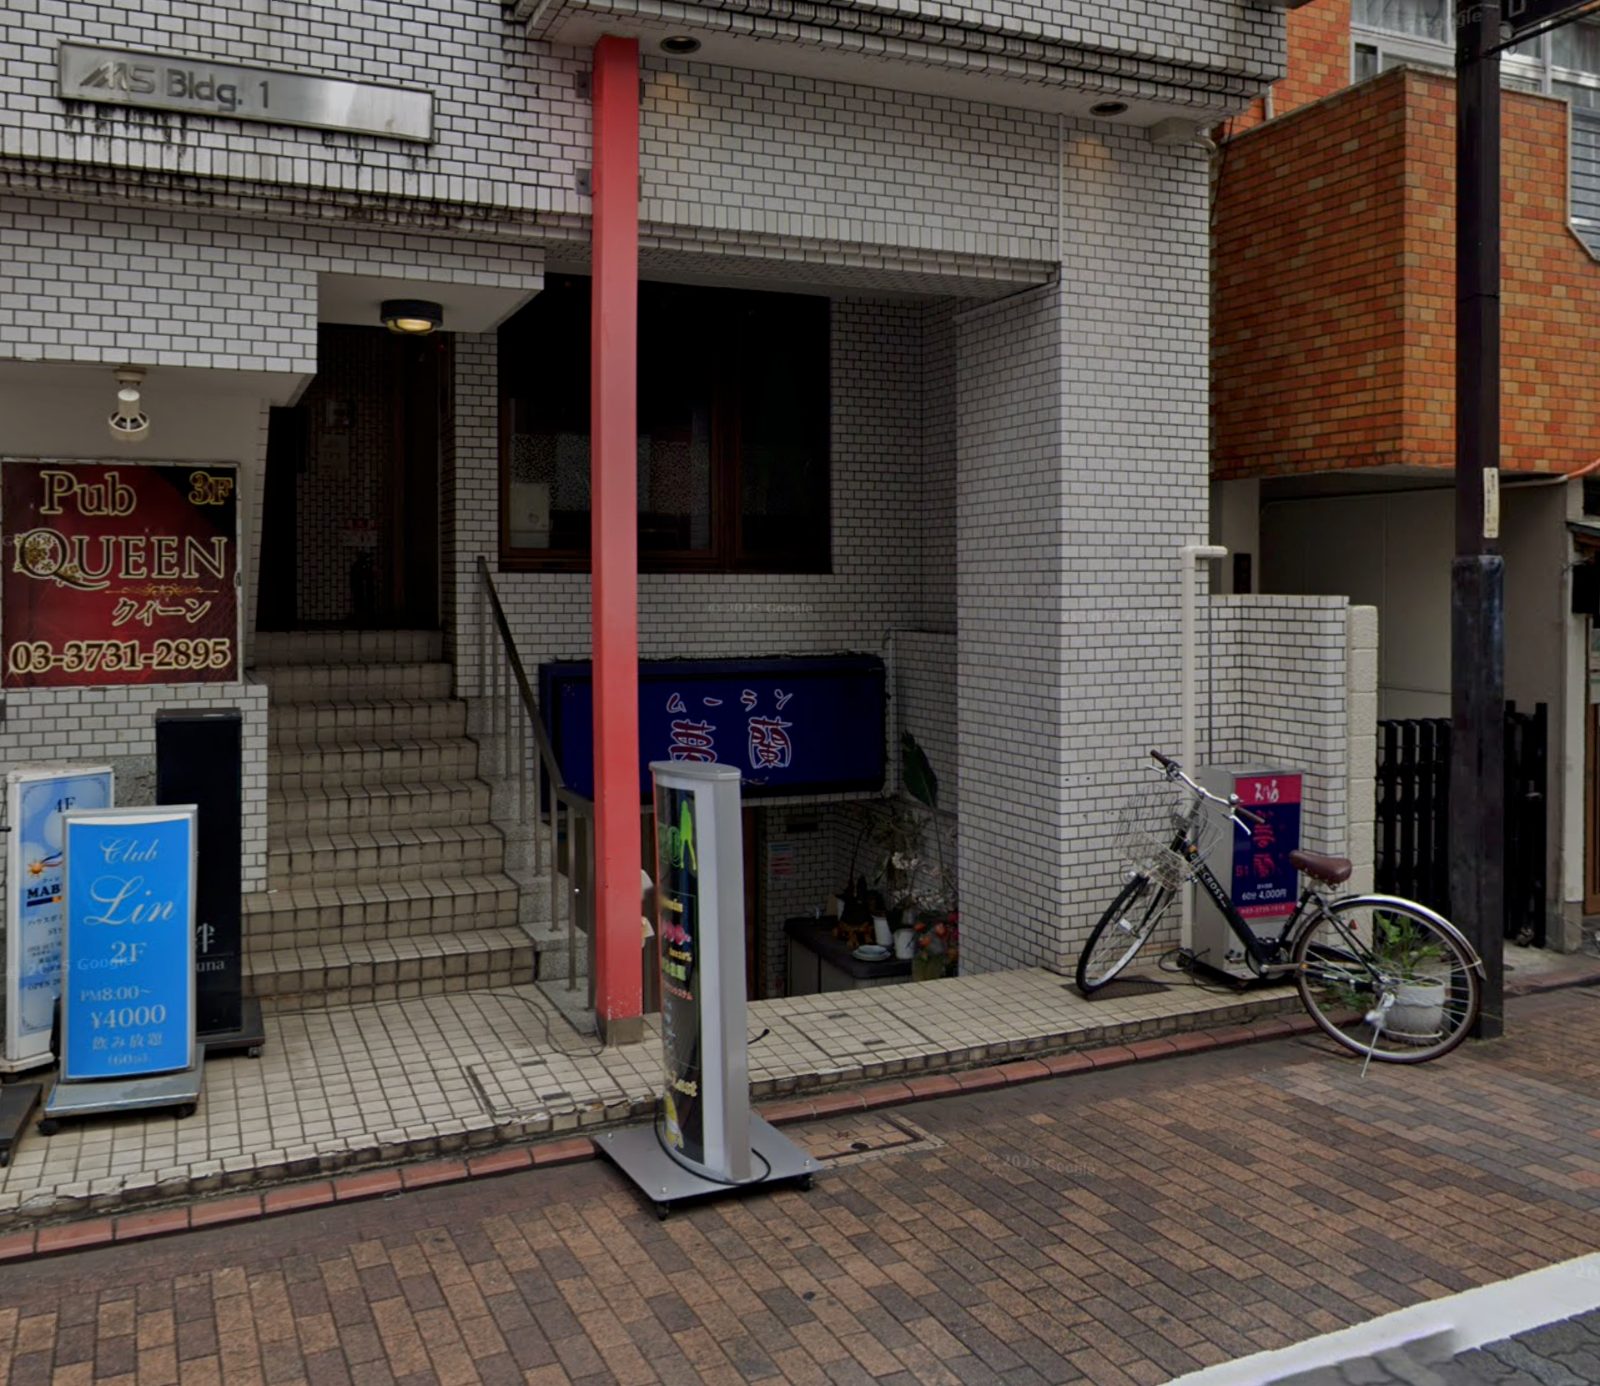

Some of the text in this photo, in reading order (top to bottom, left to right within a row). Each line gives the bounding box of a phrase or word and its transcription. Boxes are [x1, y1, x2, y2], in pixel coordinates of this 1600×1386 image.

[167, 68, 242, 112] Bldg.
[259, 80, 269, 109] 1
[40, 470, 137, 516] Pub
[188, 471, 233, 505] 3F
[13, 527, 228, 591] QUEEN
[9, 640, 231, 673] 03-3731-2895
[666, 688, 793, 713] ムーラン
[98, 838, 159, 864] Club
[83, 875, 175, 926] Lin
[111, 941, 148, 964] 2F
[92, 1032, 162, 1051] 飲み放題
